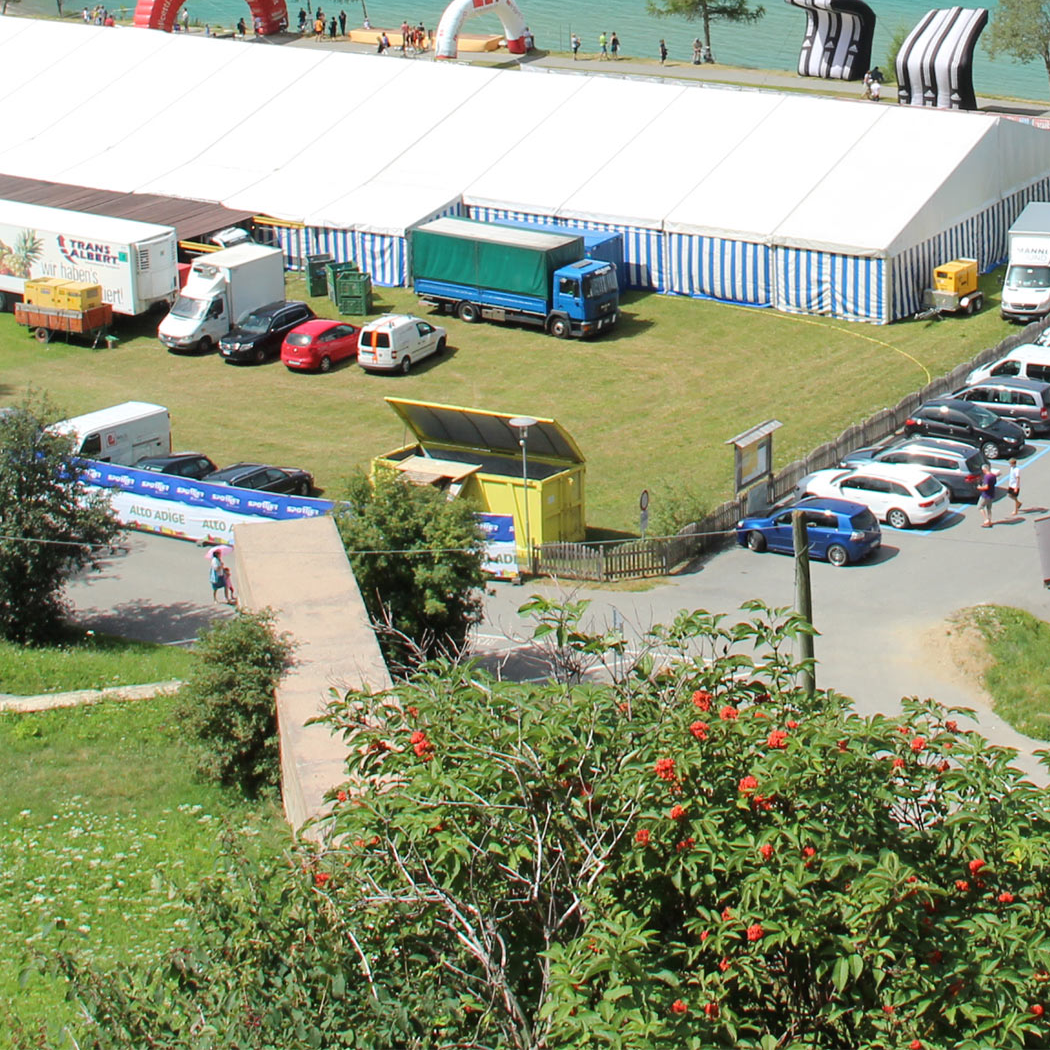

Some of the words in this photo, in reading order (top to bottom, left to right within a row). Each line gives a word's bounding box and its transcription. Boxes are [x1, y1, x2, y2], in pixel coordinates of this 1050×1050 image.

[69, 238, 110, 254] TRANS
[70, 249, 118, 264] ALBERT
[129, 505, 152, 518] ALTO
[153, 510, 186, 525] ADIGE
[202, 519, 227, 532] ALTO
